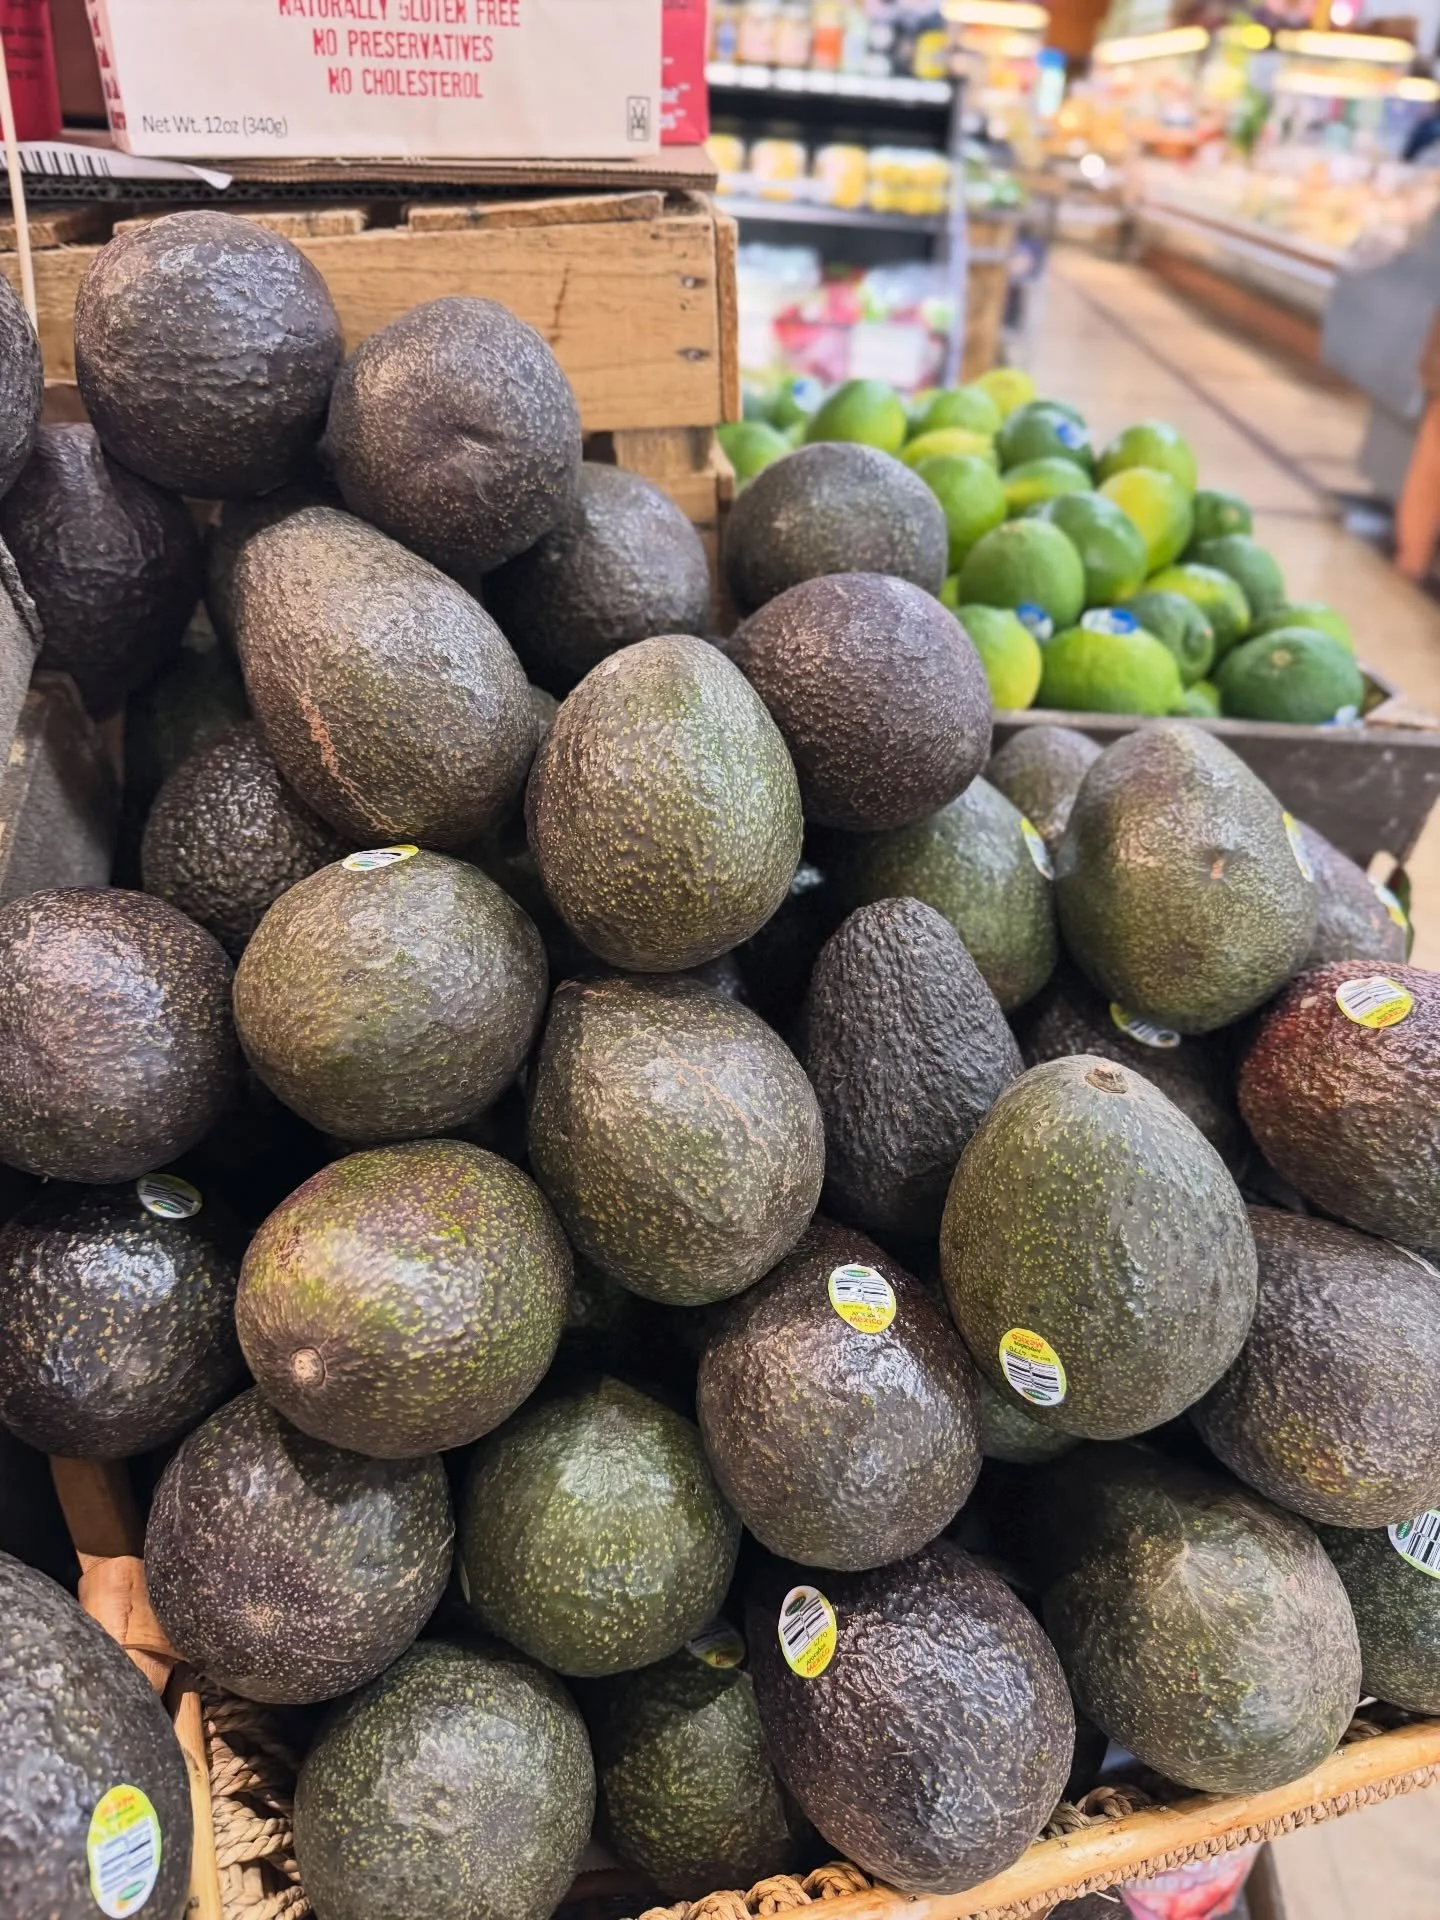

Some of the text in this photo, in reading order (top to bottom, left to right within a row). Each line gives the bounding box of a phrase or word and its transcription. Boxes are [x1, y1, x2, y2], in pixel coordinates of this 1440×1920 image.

[477, 0, 520, 27] FREE
[313, 28, 493, 61] NO PRESERVATIVES
[328, 67, 483, 98] NO CHOLESTEROL
[142, 115, 287, 138] Net Wt. 12oz (340g)
